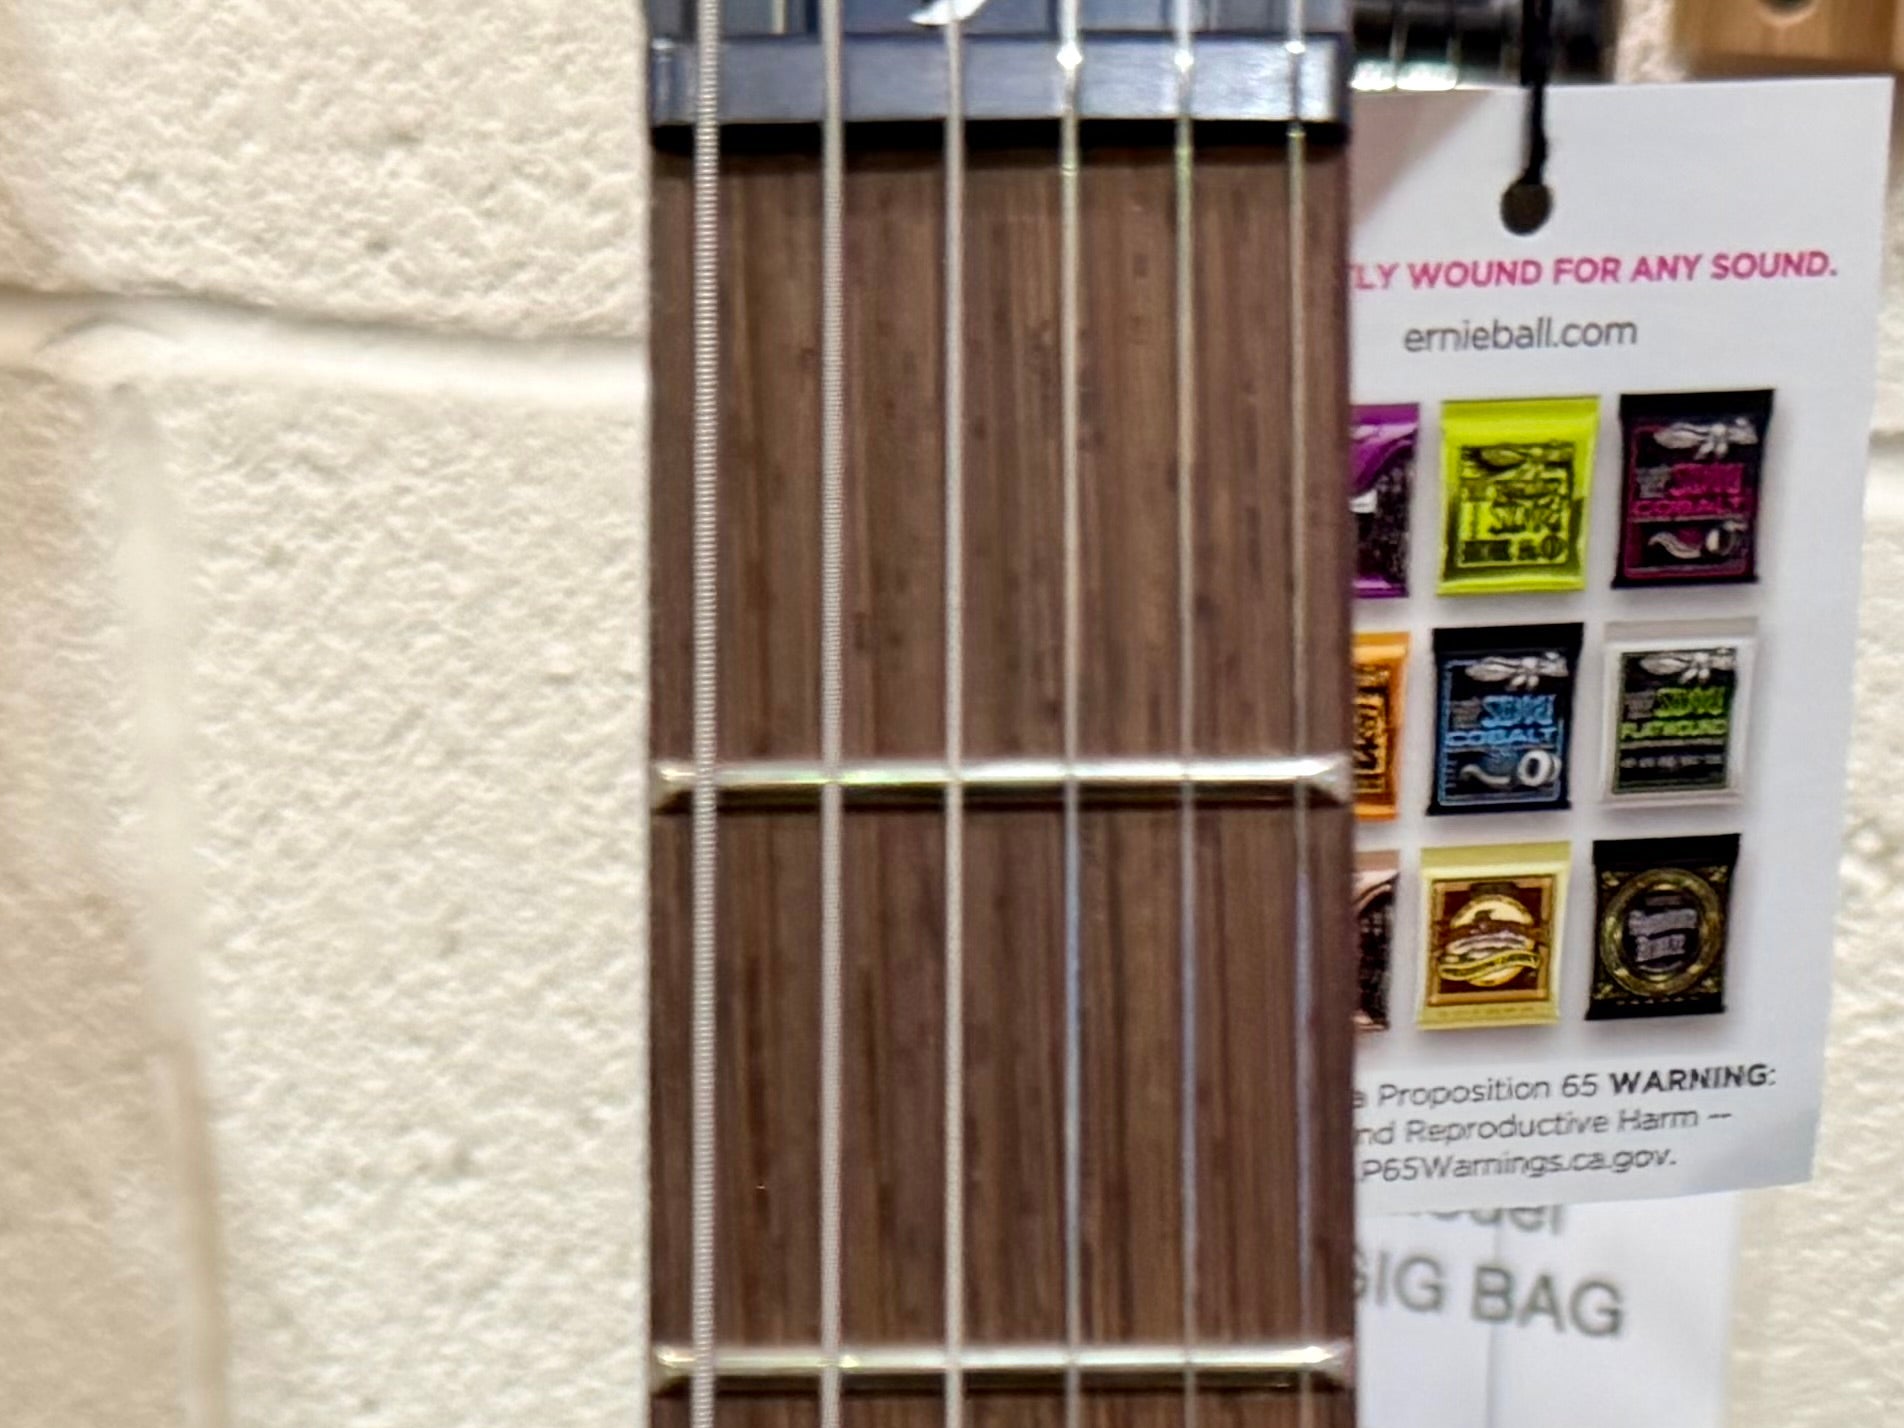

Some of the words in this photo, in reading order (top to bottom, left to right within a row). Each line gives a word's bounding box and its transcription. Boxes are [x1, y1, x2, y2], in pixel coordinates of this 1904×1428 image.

[1407, 259, 1543, 289] WOUND
[1553, 256, 1621, 285] FOR
[1630, 253, 1702, 282] ANY
[1710, 250, 1838, 281] SOUND.
[1404, 316, 1638, 353] ernieball.com
[1445, 726, 1558, 747] COBALT
[1378, 1076, 1550, 1110] Proposition
[1562, 1072, 1598, 1099] 65
[1609, 1063, 1777, 1096] WARNING:
[1406, 1110, 1609, 1148] Reproductive
[1617, 1109, 1698, 1133] Harm
[1471, 1264, 1624, 1338] BAG
